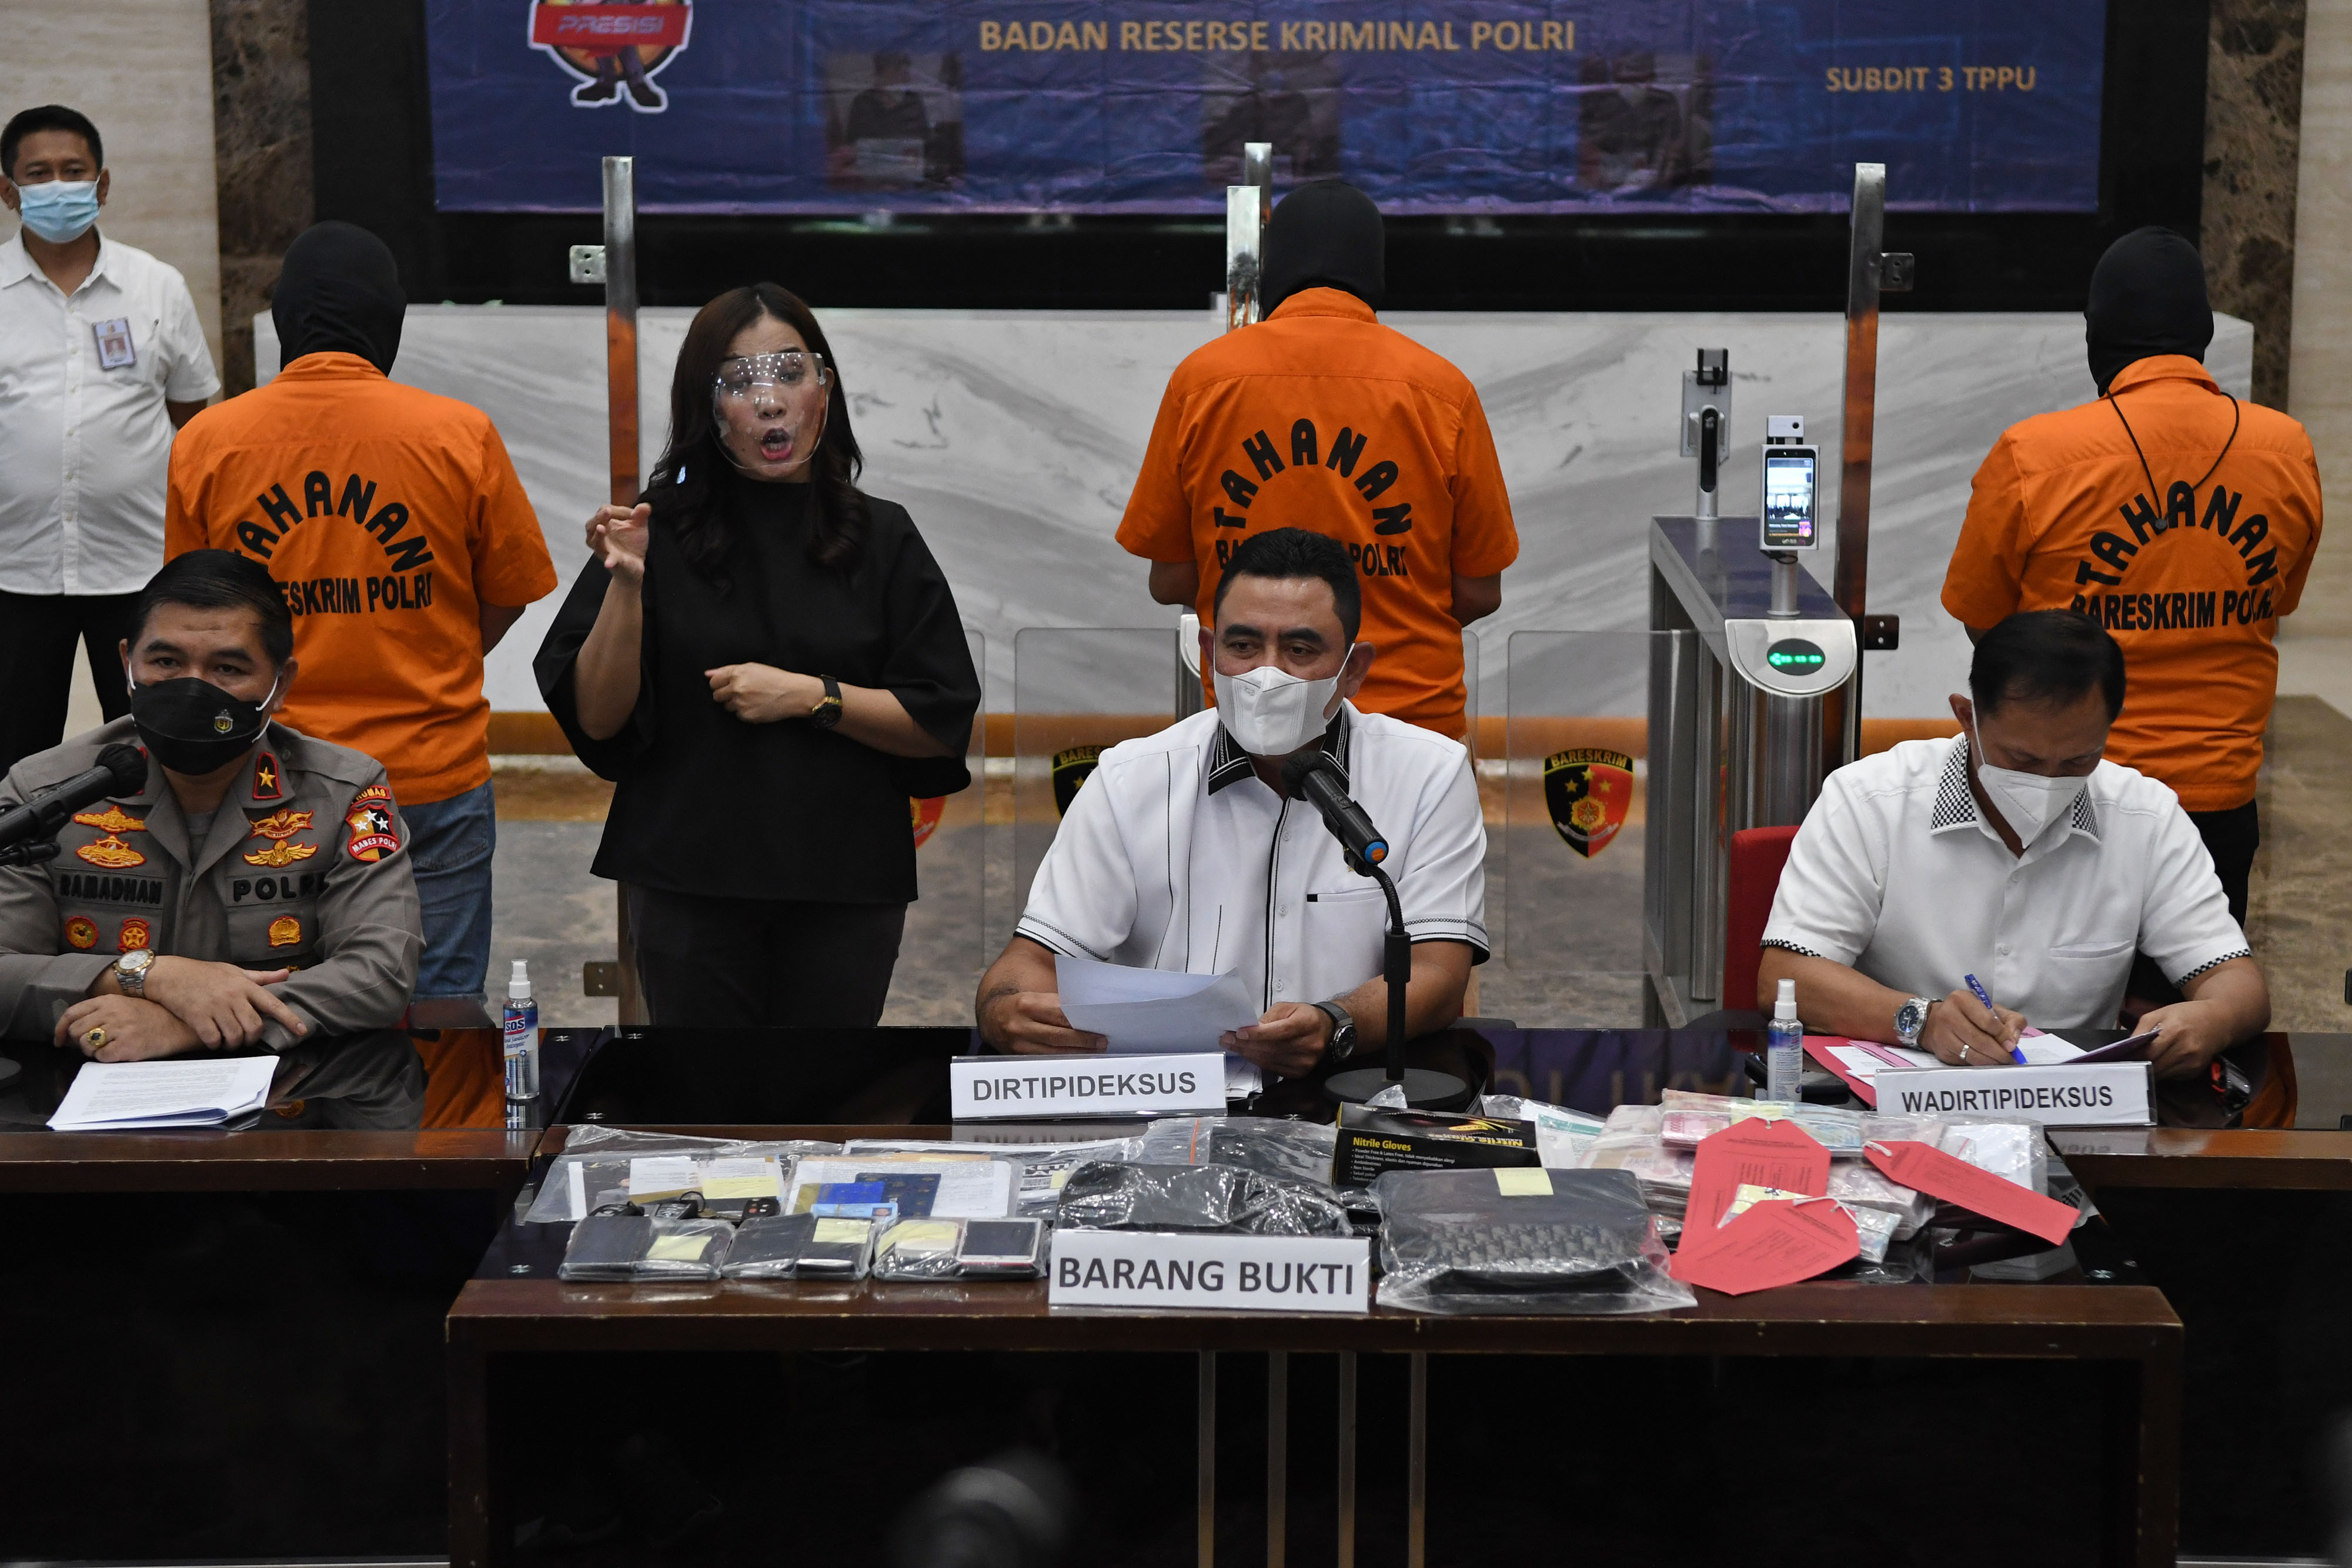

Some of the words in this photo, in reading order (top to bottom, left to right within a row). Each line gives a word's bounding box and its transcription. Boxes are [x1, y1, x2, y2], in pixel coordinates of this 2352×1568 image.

[558, 15, 664, 34] PRESISI
[980, 21, 1108, 51] BADAN
[1120, 21, 1269, 51] RESERSE
[1281, 21, 1461, 51] KRIMINAL
[1471, 21, 1575, 51] POLRI
[1825, 66, 1929, 92] SUBDIT
[1939, 67, 1953, 92] 3
[1962, 67, 2036, 92] TPPU
[1214, 418, 1412, 536] TAHANAN
[235, 470, 434, 573] AHANAN
[2074, 480, 2278, 586] TAHANAN
[366, 571, 432, 613] POLRI
[1550, 749, 1628, 768] BARESKRIM
[352, 837, 377, 853] MABES
[378, 837, 397, 851] POLRI
[60, 874, 162, 905] RAMADHAN
[973, 1072, 1197, 1101] DIRTIPIDEKSUS
[1902, 1085, 2113, 1112] WADIRTIPIDEKSUS
[1353, 1137, 1380, 1148] Nitrile
[1382, 1140, 1411, 1151] Gloves
[1059, 1257, 1225, 1291] BARANG
[1240, 1262, 1353, 1295] BUKTI
